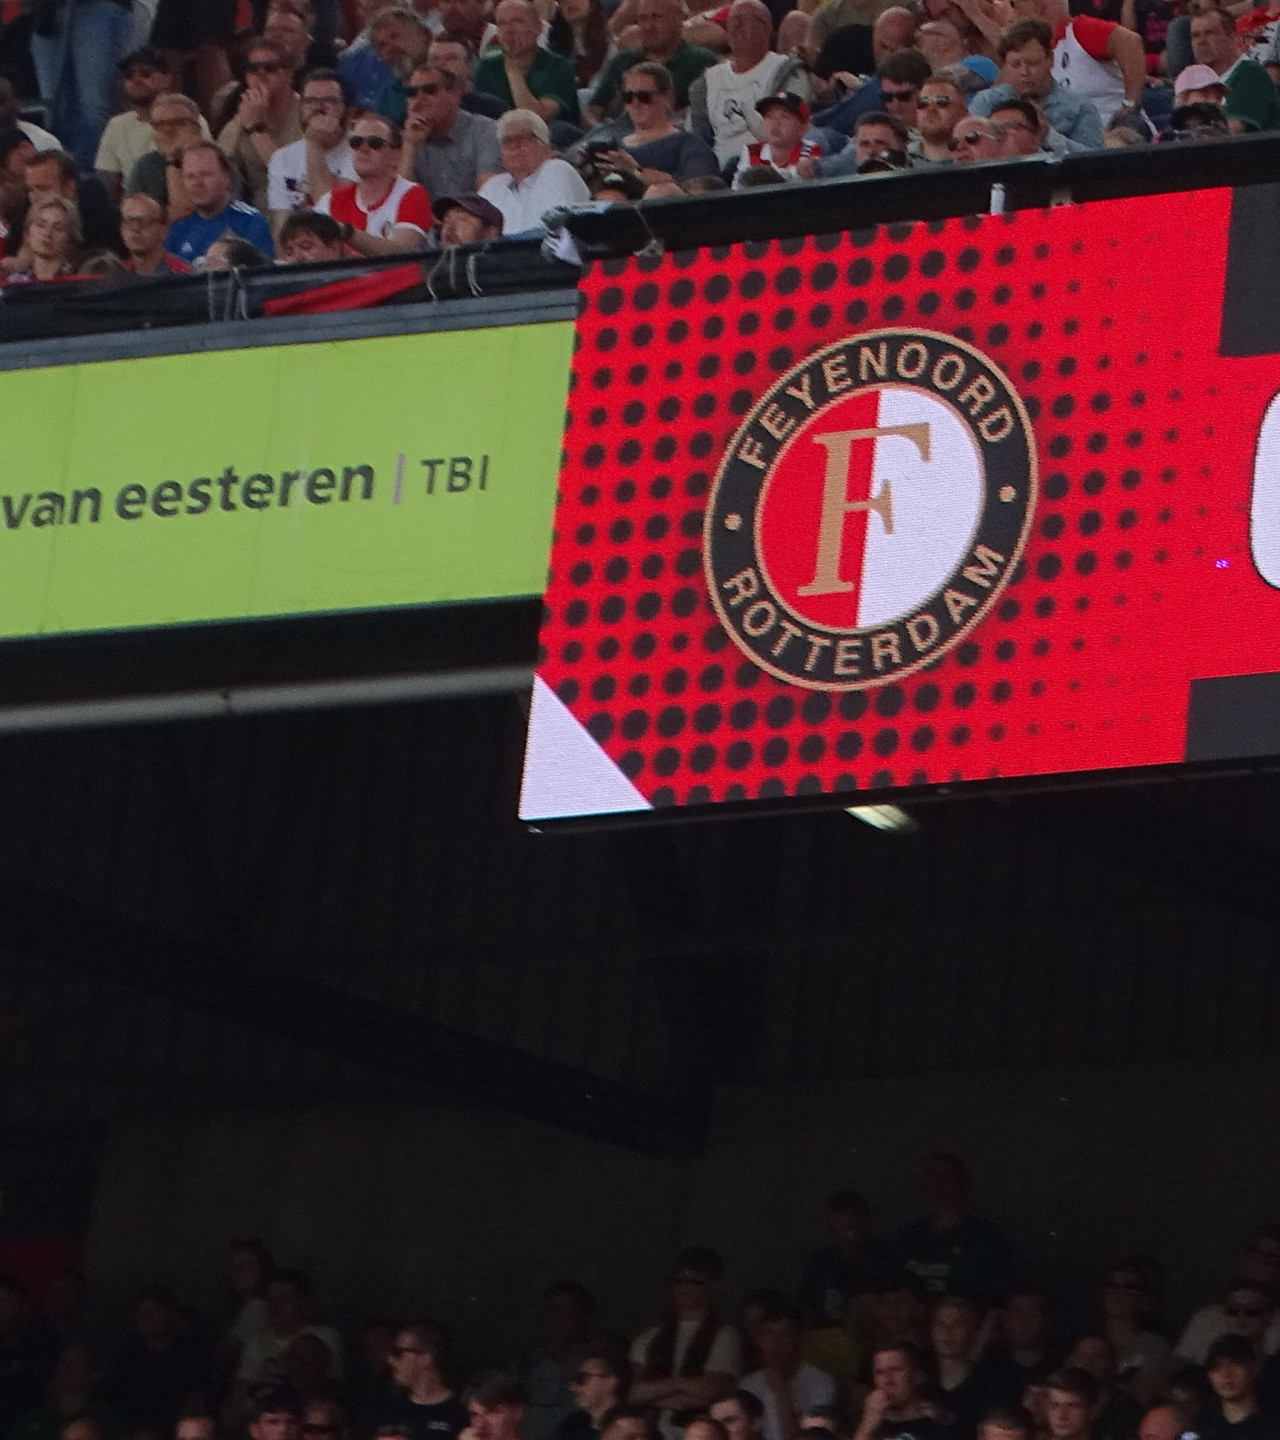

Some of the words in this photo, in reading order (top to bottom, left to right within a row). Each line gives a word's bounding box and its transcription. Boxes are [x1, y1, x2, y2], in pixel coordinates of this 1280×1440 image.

[738, 341, 1016, 470] FEYENOORD
[1, 486, 102, 530] van
[114, 463, 375, 522] eesteren
[420, 454, 490, 495] TBI
[797, 421, 932, 597] F
[722, 543, 1005, 675] ROTTERDAM
